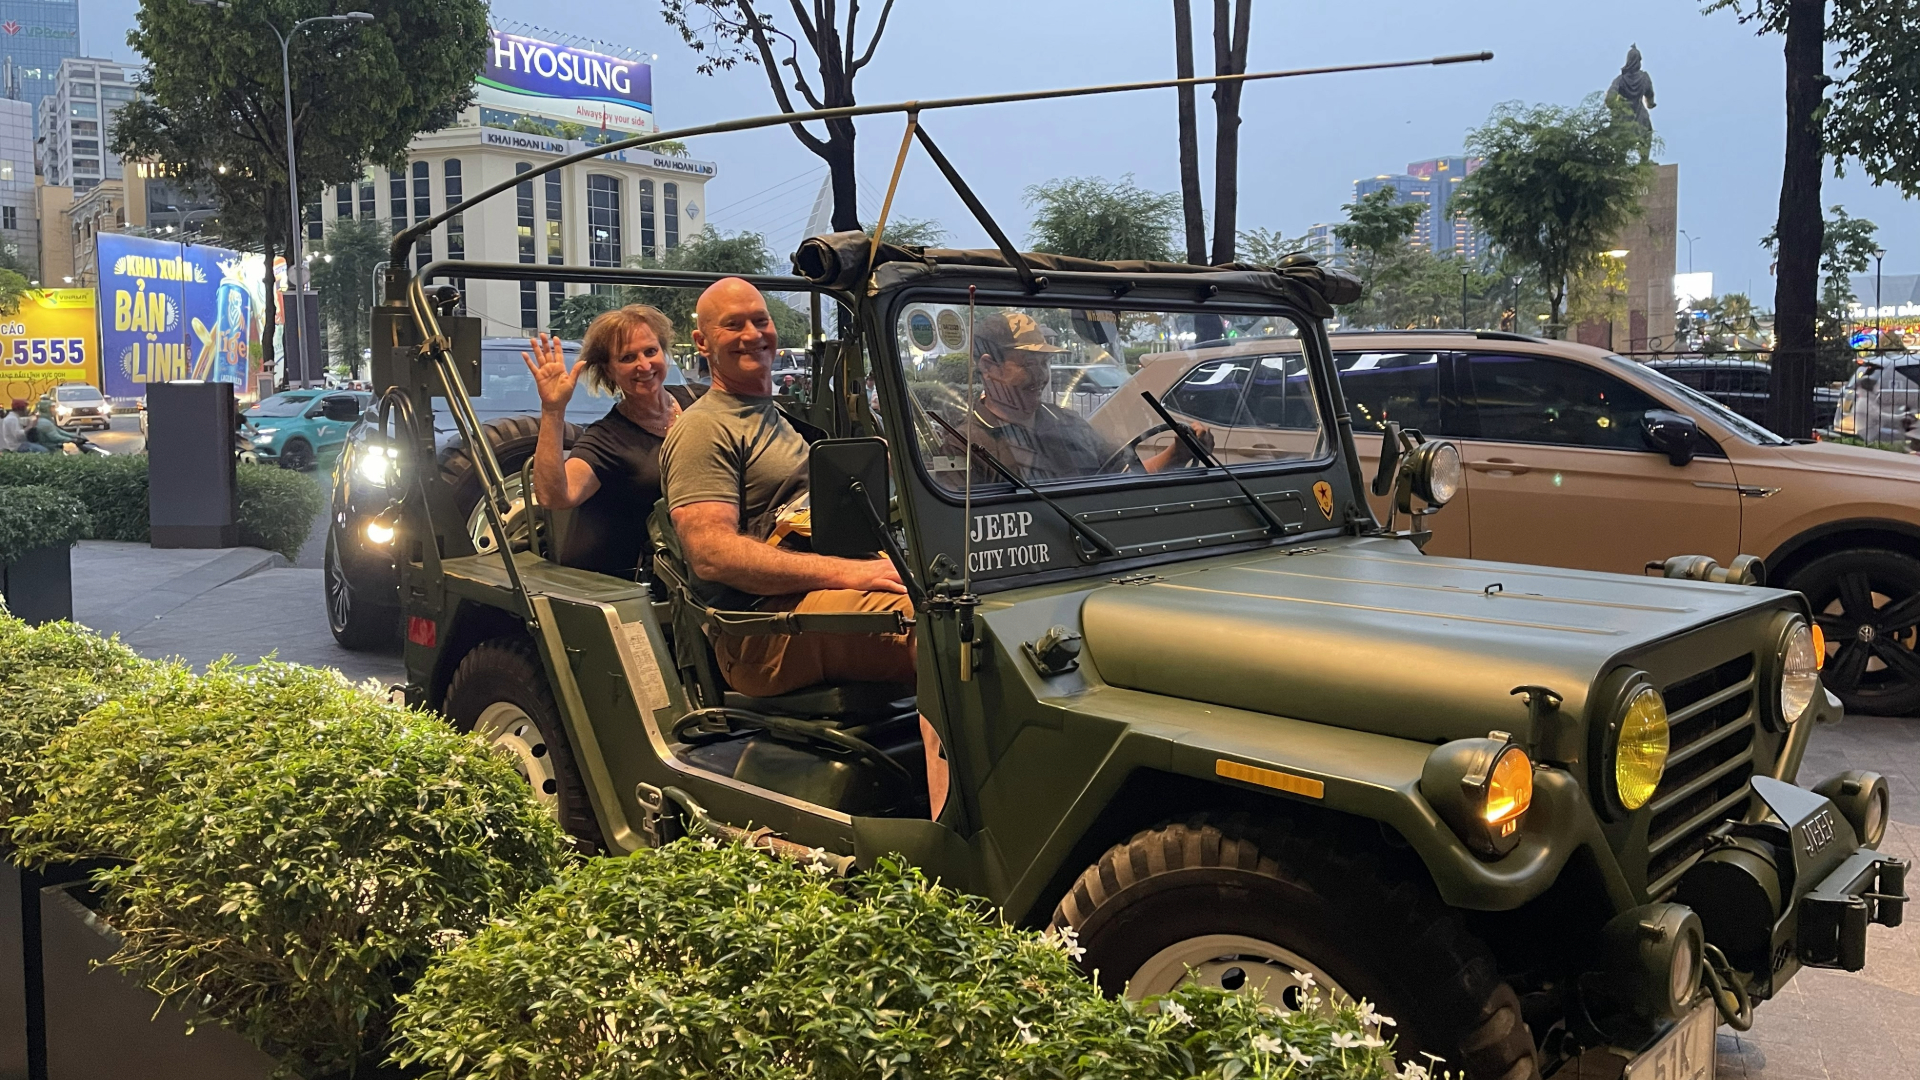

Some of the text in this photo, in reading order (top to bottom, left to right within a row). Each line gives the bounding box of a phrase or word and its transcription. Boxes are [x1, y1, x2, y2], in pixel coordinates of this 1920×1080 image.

[493, 37, 631, 94] HYOSUNG
[576, 105, 602, 120] Always
[614, 115, 630, 124] your
[631, 116, 645, 126] side
[487, 133, 564, 153] KHAI HOAN LAND
[653, 158, 713, 174] KHAI HOAN LAND
[126, 254, 193, 282] KHAI XUÂN
[115, 278, 166, 333] BẢN
[1, 321, 25, 335] CÁO
[0, 338, 85, 366] .5555
[131, 332, 186, 384] LĨNH
[970, 511, 1033, 542] JEEP
[968, 543, 1050, 573] CITY TOUR
[1801, 810, 1836, 858] JEEP
[1654, 1024, 1691, 1080] 51K
